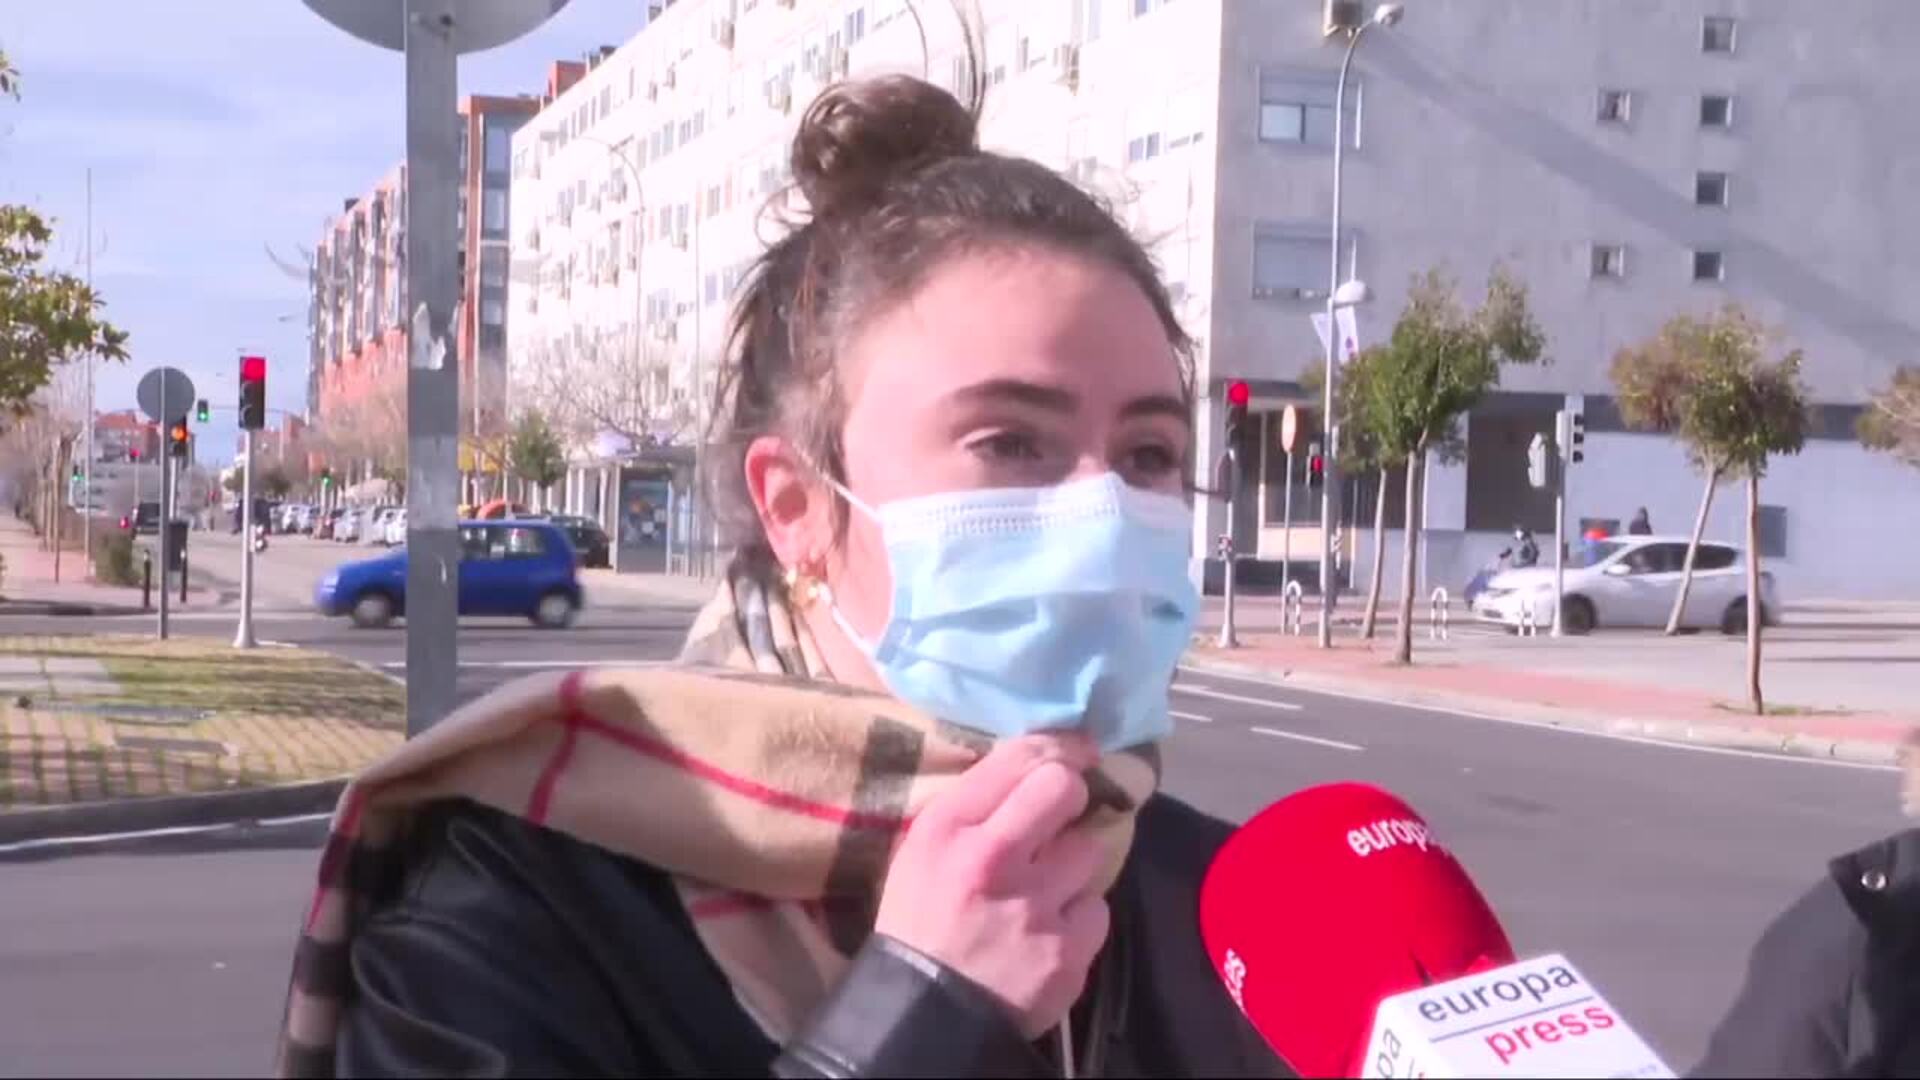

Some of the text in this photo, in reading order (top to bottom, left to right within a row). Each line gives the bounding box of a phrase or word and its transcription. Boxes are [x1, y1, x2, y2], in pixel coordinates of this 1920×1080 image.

[1347, 818, 1429, 856] europ
[1418, 965, 1579, 1021] europa
[1485, 1006, 1615, 1064] press
